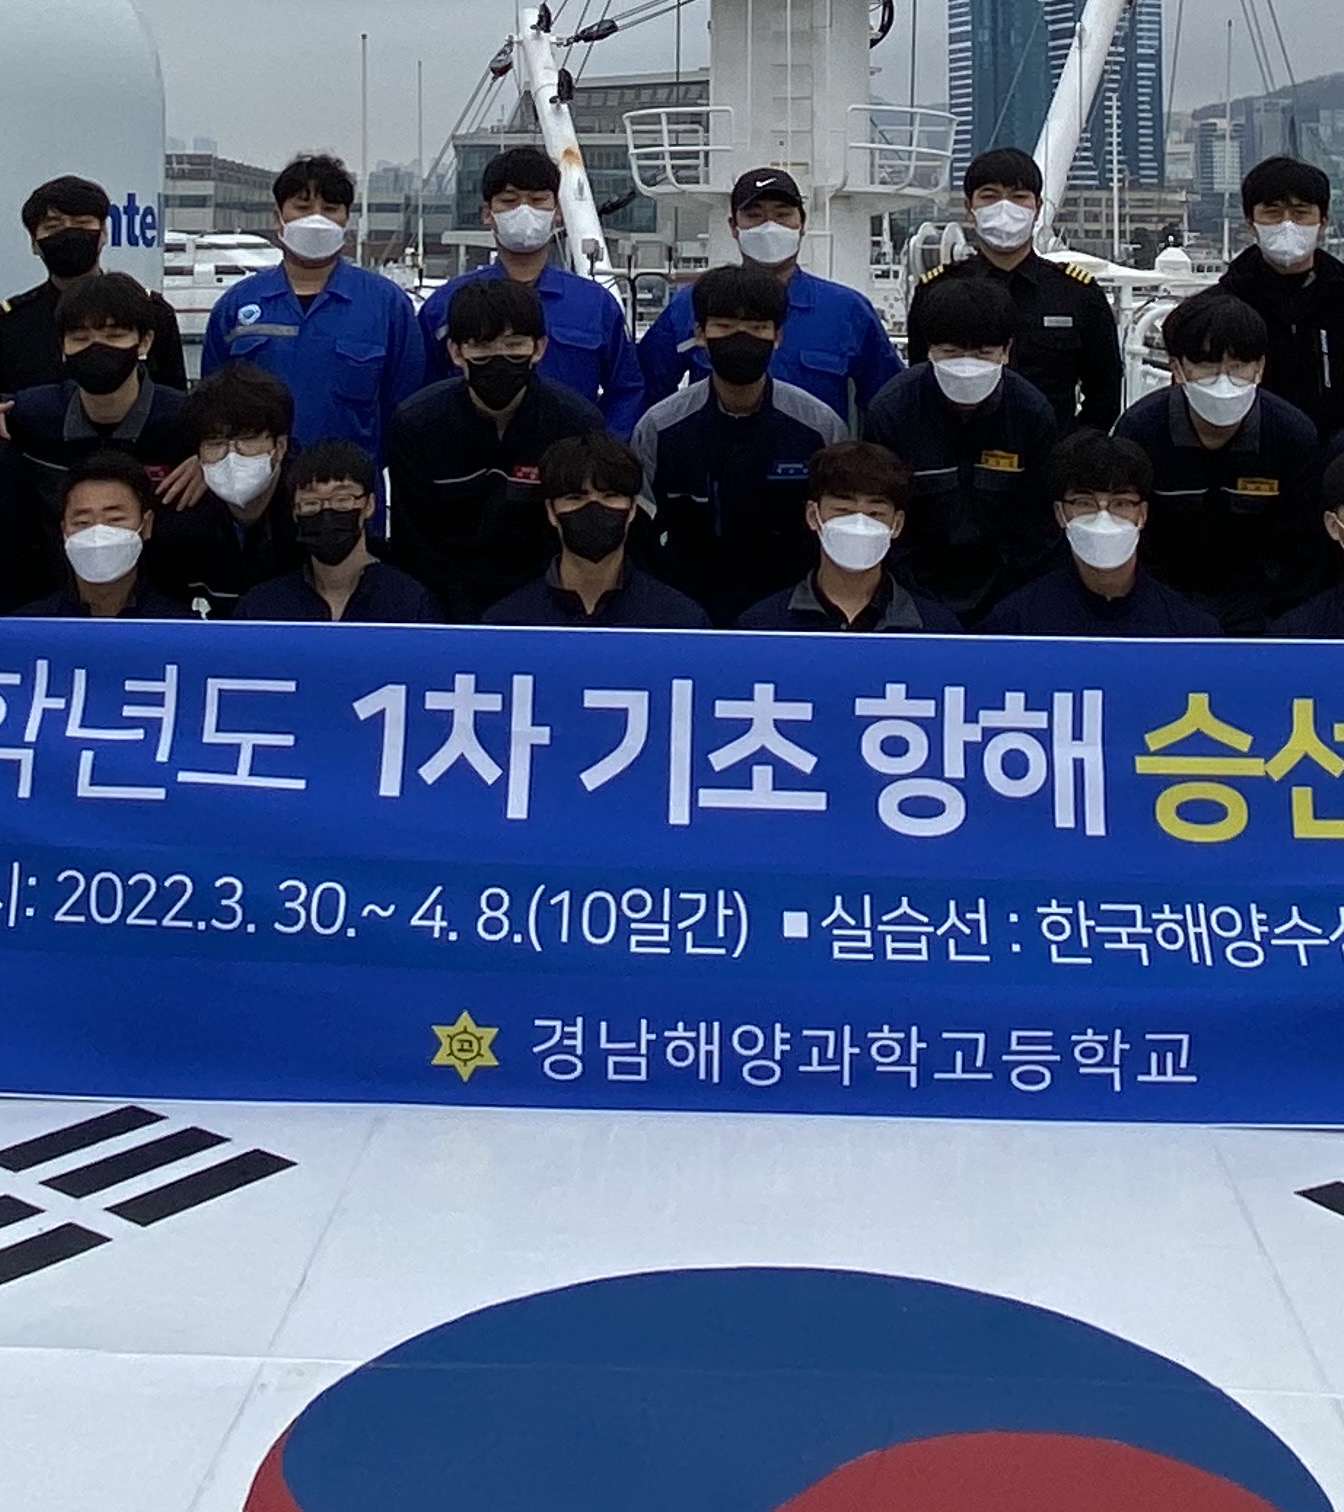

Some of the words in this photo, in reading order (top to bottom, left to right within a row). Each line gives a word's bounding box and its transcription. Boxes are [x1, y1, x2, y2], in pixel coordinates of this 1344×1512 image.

[352, 673, 551, 820] 1차
[579, 679, 828, 826] 기초
[855, 682, 1107, 837] 항해
[532, 1016, 1198, 1092] 경남해양과학고등학교
